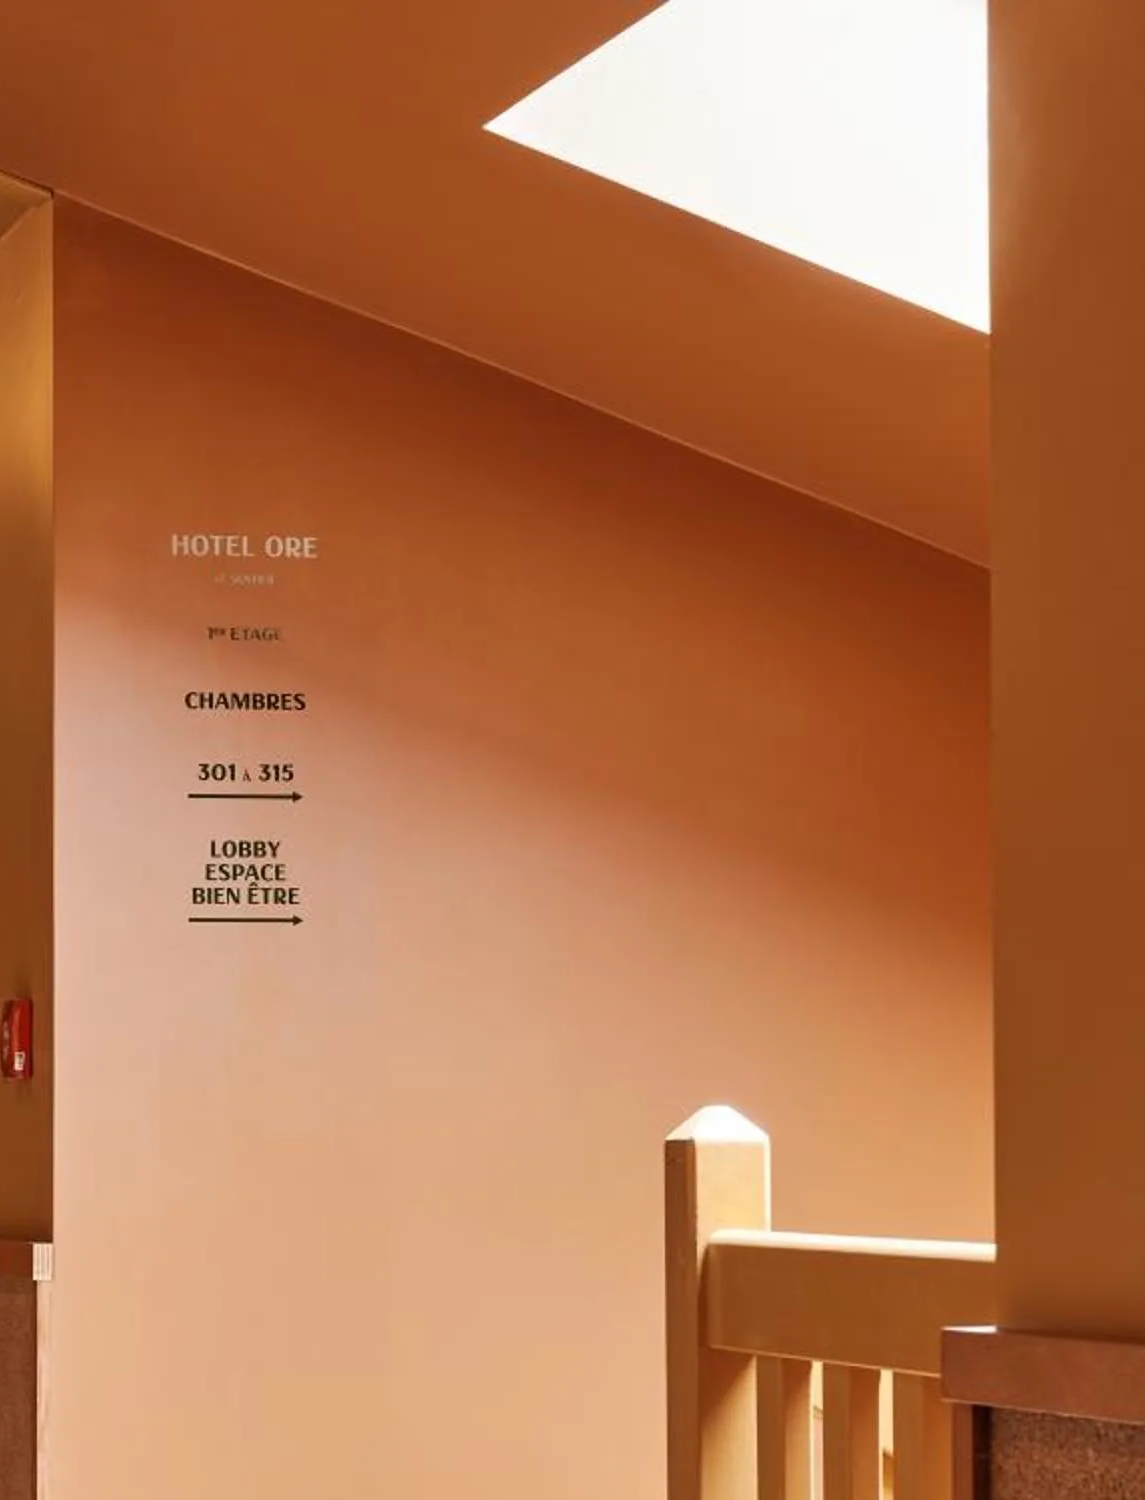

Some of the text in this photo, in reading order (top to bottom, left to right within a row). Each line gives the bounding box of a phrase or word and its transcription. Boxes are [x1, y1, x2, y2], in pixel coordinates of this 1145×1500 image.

[171, 533, 319, 559] HOTEL ORE
[184, 691, 307, 711] CHAMBRES
[198, 763, 236, 782] 301
[258, 763, 295, 782] 315
[210, 840, 280, 858] LOBBY
[205, 863, 286, 881] ESPACE
[191, 881, 301, 905] BIEN ÊTRE
